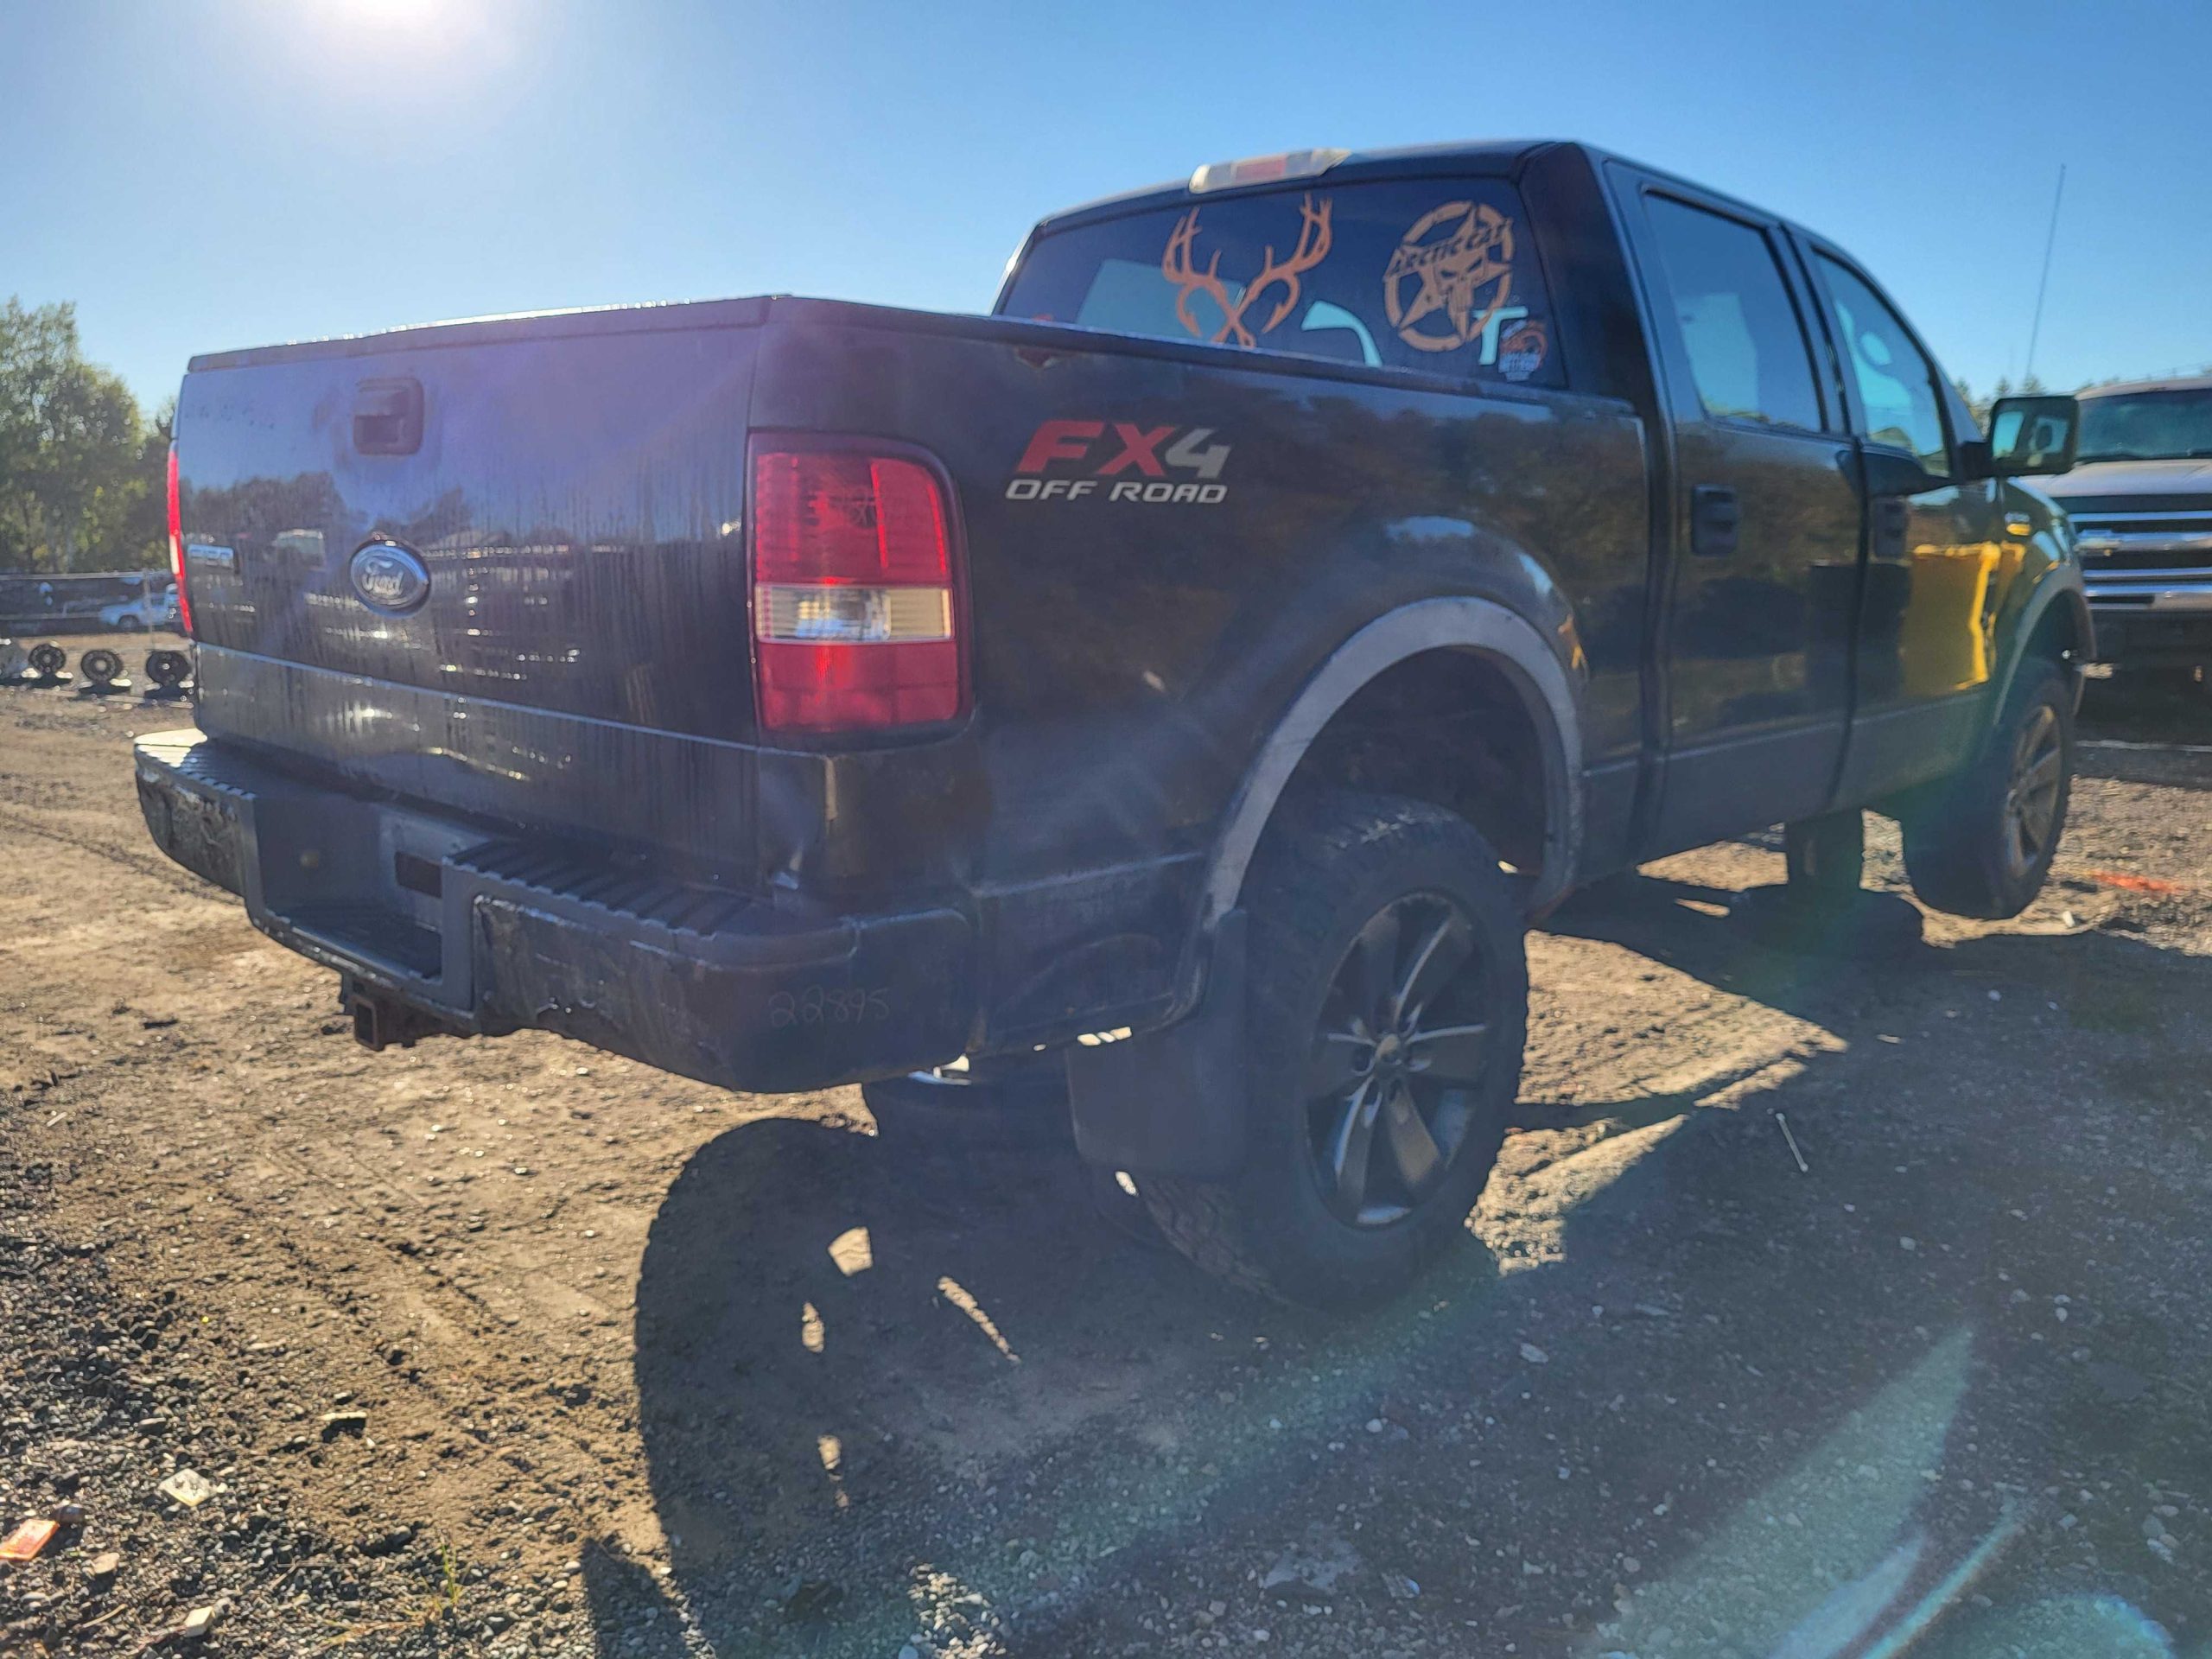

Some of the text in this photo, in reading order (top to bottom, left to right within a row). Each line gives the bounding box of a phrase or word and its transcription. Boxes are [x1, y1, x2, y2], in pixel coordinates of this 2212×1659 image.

[1016, 420, 1231, 478] FX4
[1005, 479, 1228, 504] OFF ROAD
